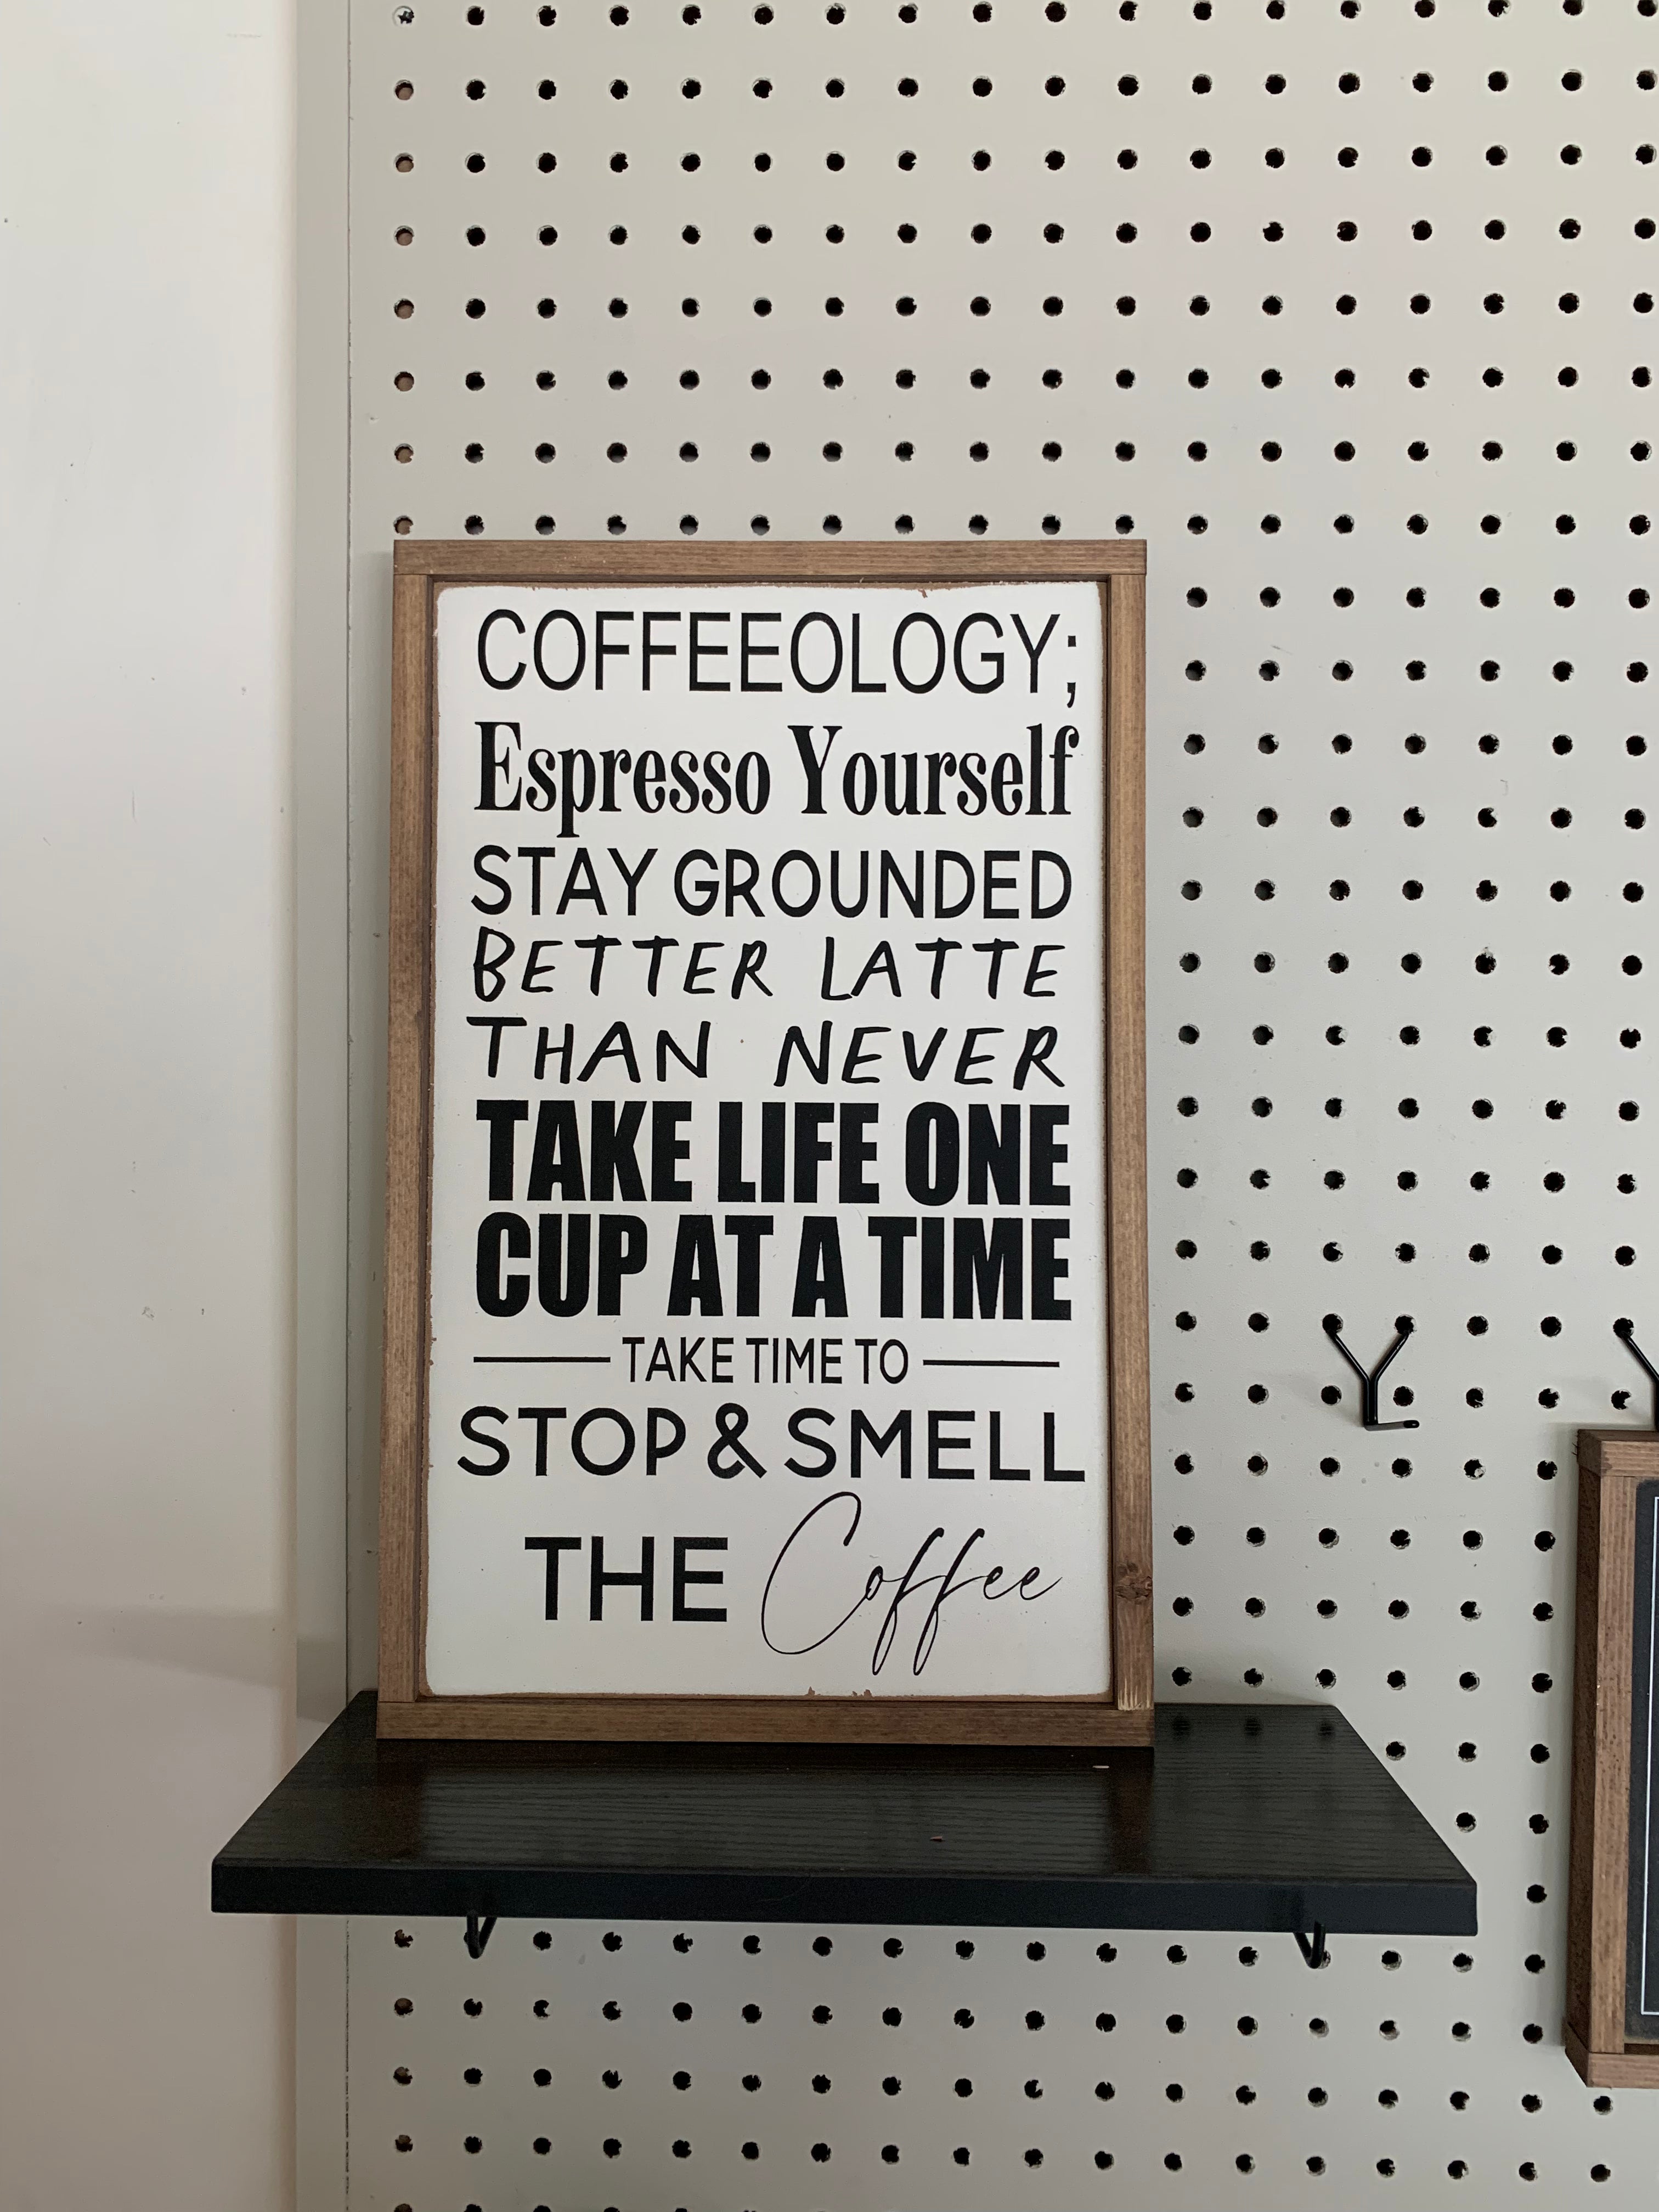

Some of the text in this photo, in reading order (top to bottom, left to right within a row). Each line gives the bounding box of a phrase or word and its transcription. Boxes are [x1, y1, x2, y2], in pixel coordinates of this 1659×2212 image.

[478, 609, 1077, 708] COFFEEOLOGY;
[473, 721, 1080, 838] Espresso Yourself
[471, 844, 1072, 919] STAY GROUNDED
[473, 926, 1065, 1002] BETTER LATTE
[466, 1016, 1065, 1091] THAN NEVER
[476, 1099, 1071, 1206] TAKE LIFE ONE
[476, 1211, 1072, 1321] CUP AT A TIME
[622, 1336, 909, 1384] TAKE TIME TO
[457, 1402, 1085, 1482] STOP & SMELL
[524, 1491, 1063, 1676] THE Coffee
